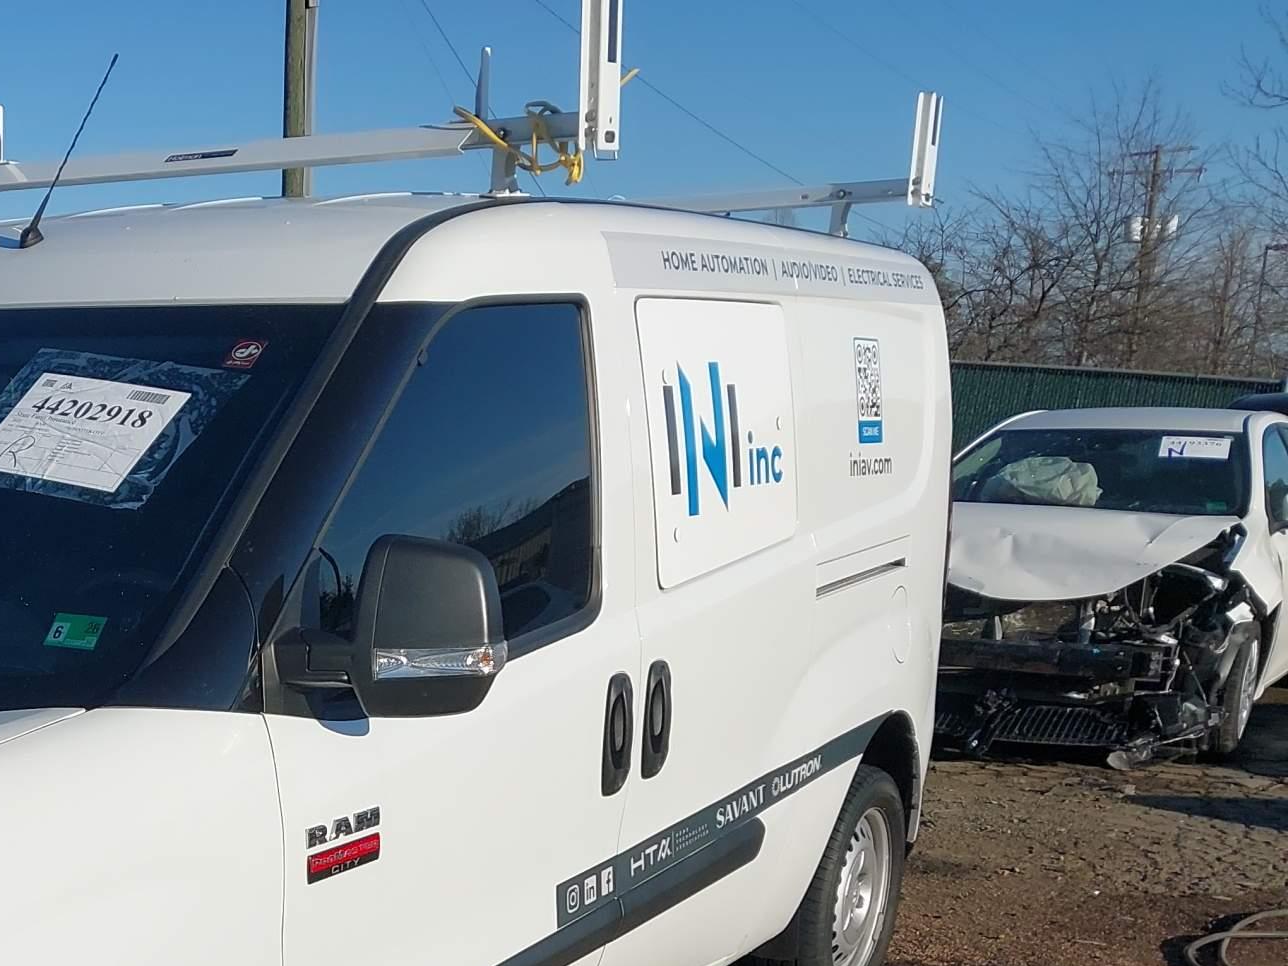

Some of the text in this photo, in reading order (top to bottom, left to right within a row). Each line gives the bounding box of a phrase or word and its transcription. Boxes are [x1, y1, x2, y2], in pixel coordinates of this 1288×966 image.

[661, 250, 698, 271] HOME
[700, 253, 769, 276] AUTOMATION
[781, 259, 838, 282] AUDIO/VIDEO
[847, 267, 893, 287] ELECTRICAL
[893, 271, 924, 290] SERVICES
[31, 395, 153, 429] 44202918
[747, 430, 784, 486] inc
[849, 452, 893, 477] iniav.com
[53, 624, 65, 639] 6
[715, 784, 766, 829] SAVANT
[305, 806, 380, 849] RAM
[332, 857, 361, 874] CITY
